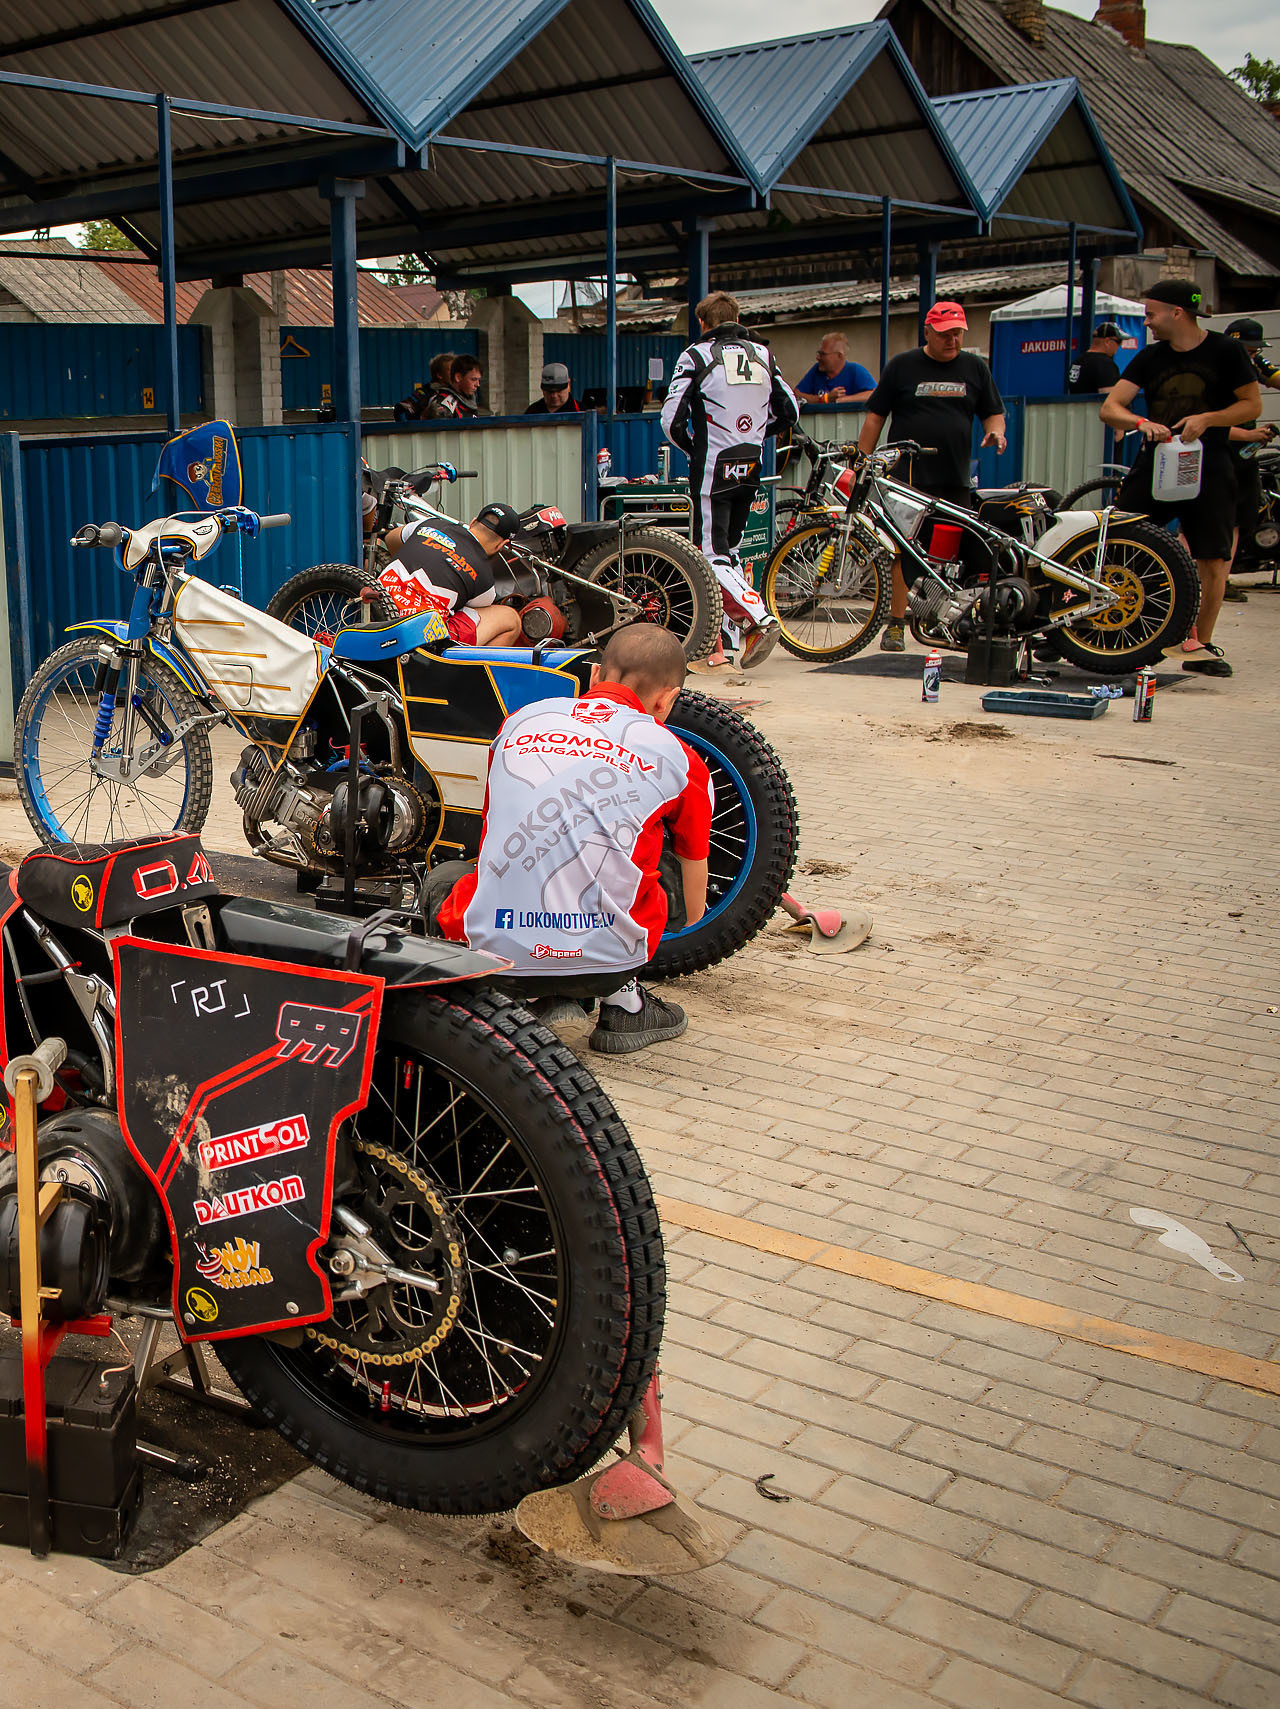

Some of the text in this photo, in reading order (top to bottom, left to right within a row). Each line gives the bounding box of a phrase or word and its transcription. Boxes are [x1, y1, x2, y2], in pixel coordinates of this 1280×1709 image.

[1022, 340, 1066, 354] JAKUBIN
[736, 354, 753, 382] 4
[143, 391, 154, 406] 14
[503, 732, 656, 774] LOKOMOTIV
[518, 745, 633, 774] DAUGAVPILS
[519, 911, 616, 929] LOKOMOTIVE.LV
[202, 1122, 307, 1163] PRINTSOL
[195, 1177, 304, 1223] DAUTKOM
[219, 1267, 274, 1290] KEBAB
